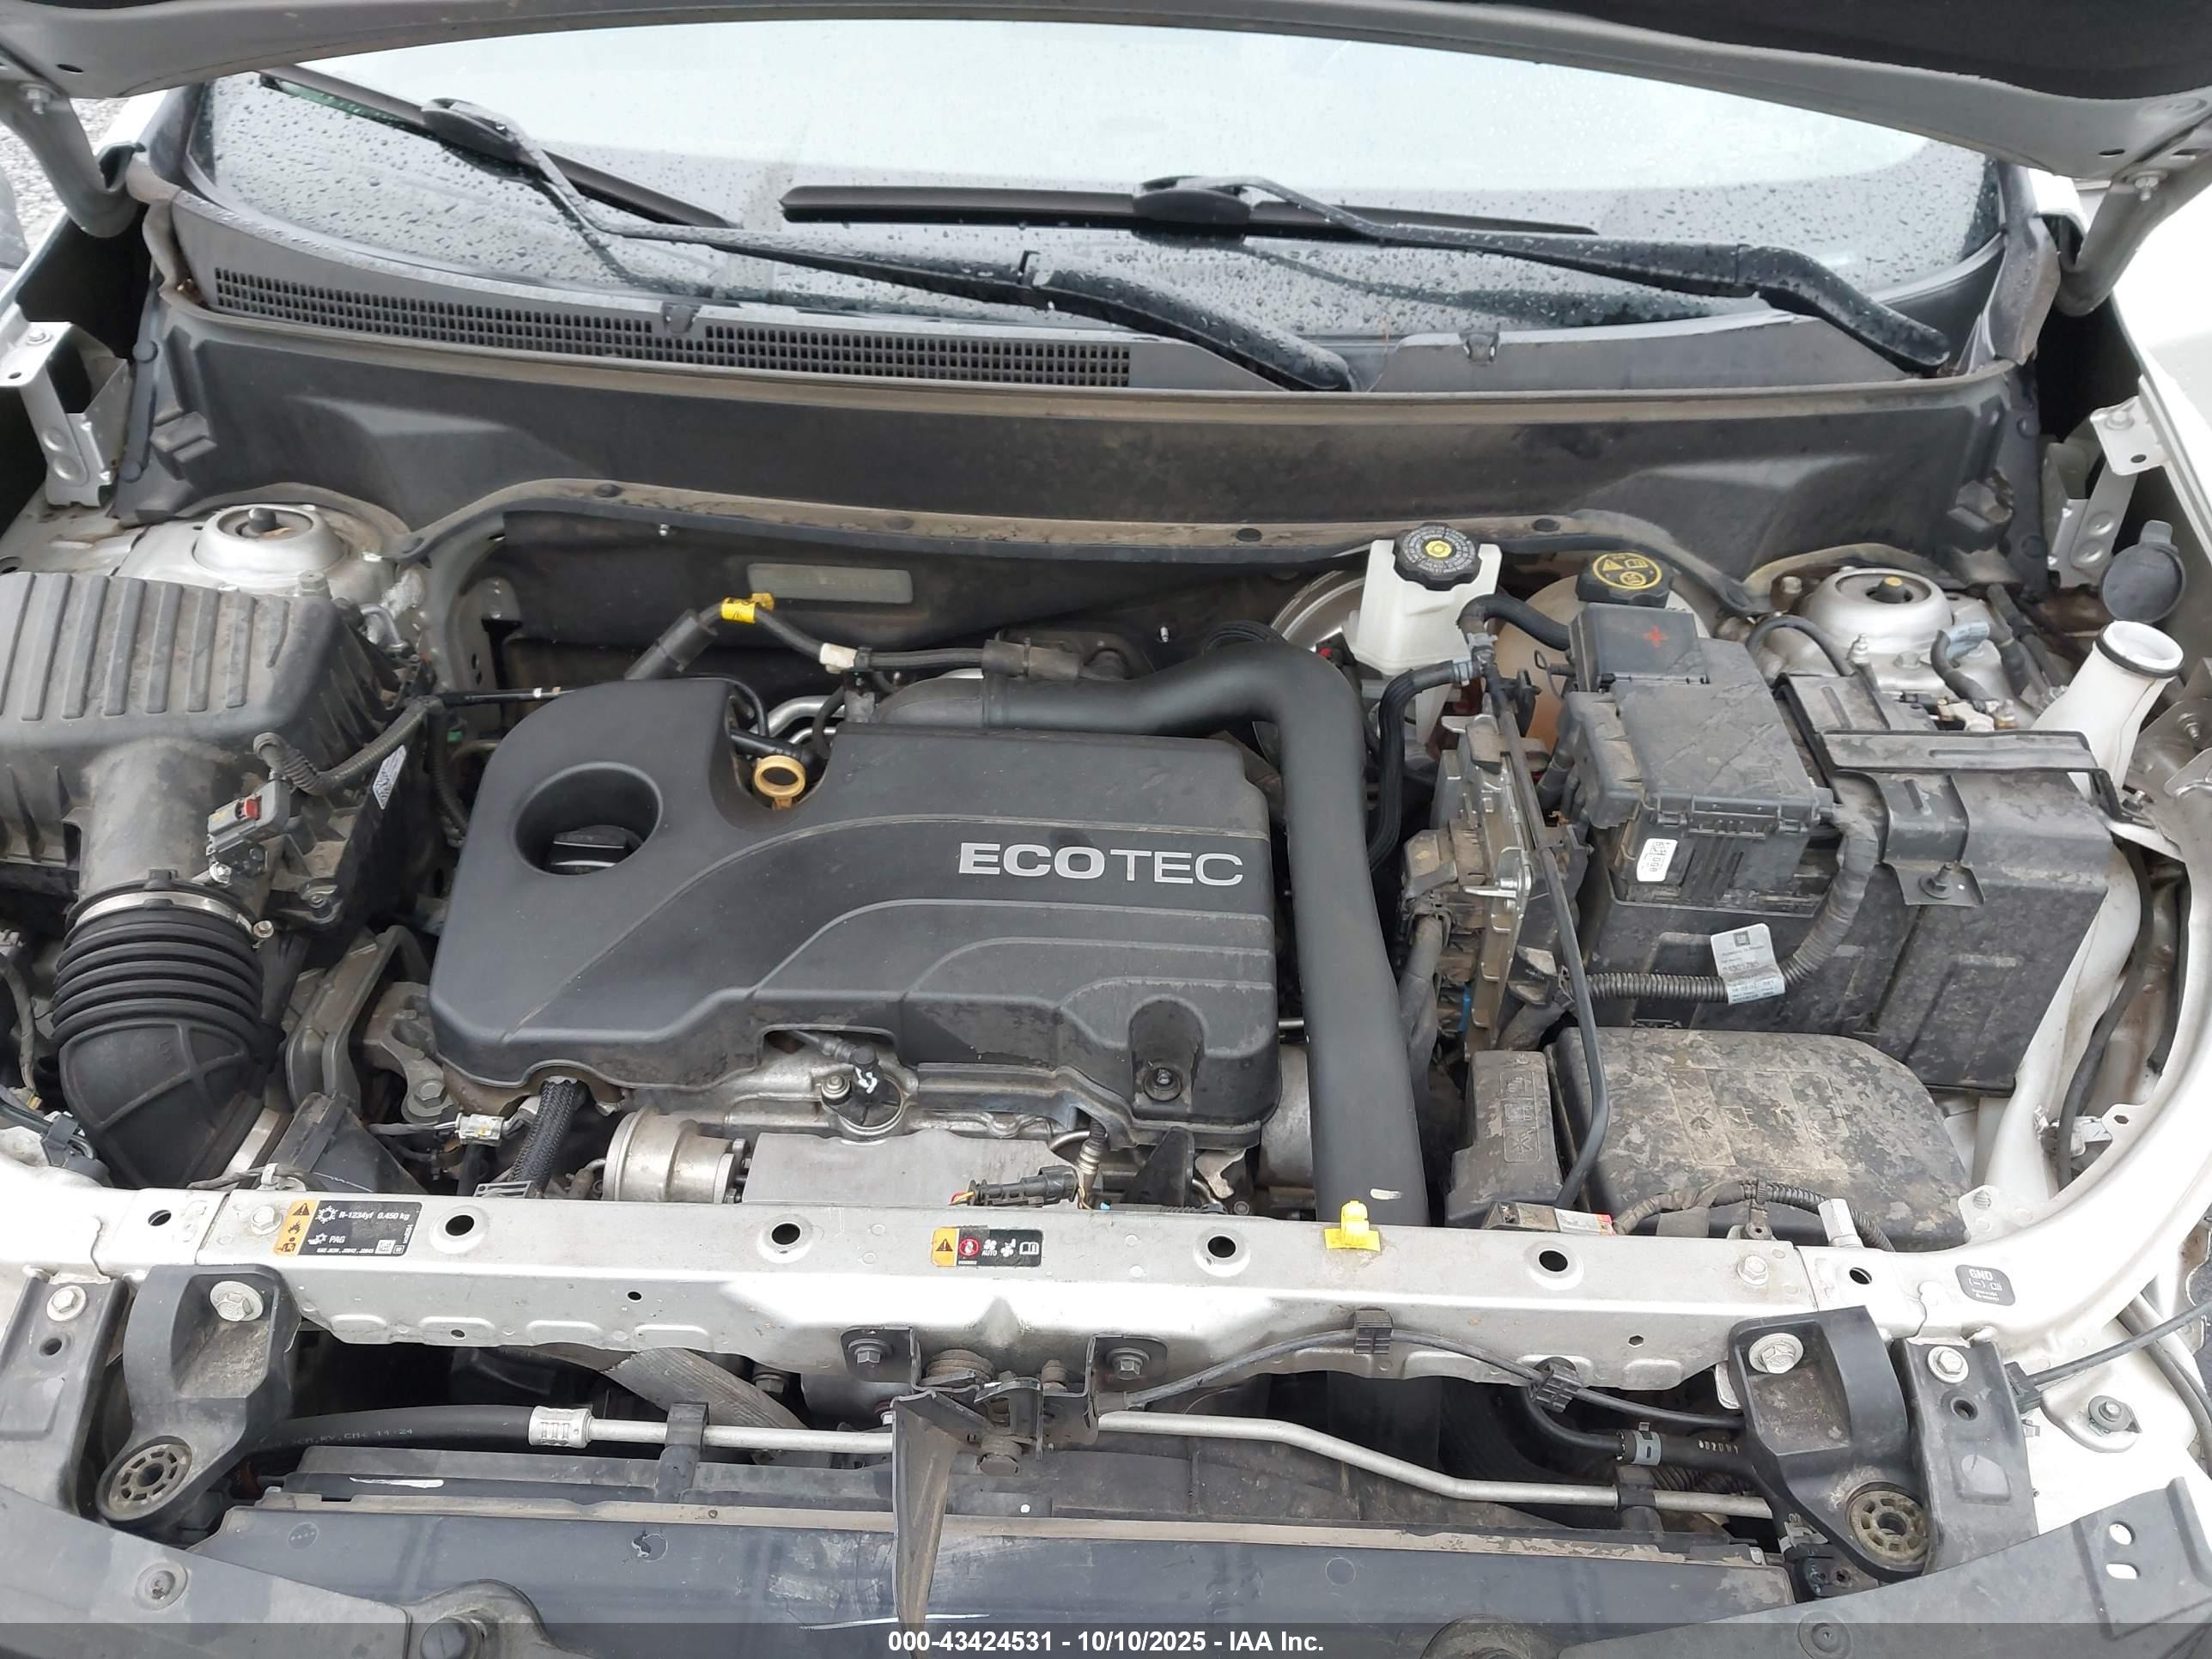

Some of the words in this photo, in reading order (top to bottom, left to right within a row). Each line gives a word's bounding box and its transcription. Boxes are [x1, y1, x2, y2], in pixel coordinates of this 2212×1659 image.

[958, 842, 1243, 886] ECOTEC
[399, 1212, 410, 1221] kg
[328, 1235, 346, 1244] PAG
[1968, 1268, 1993, 1281] GND
